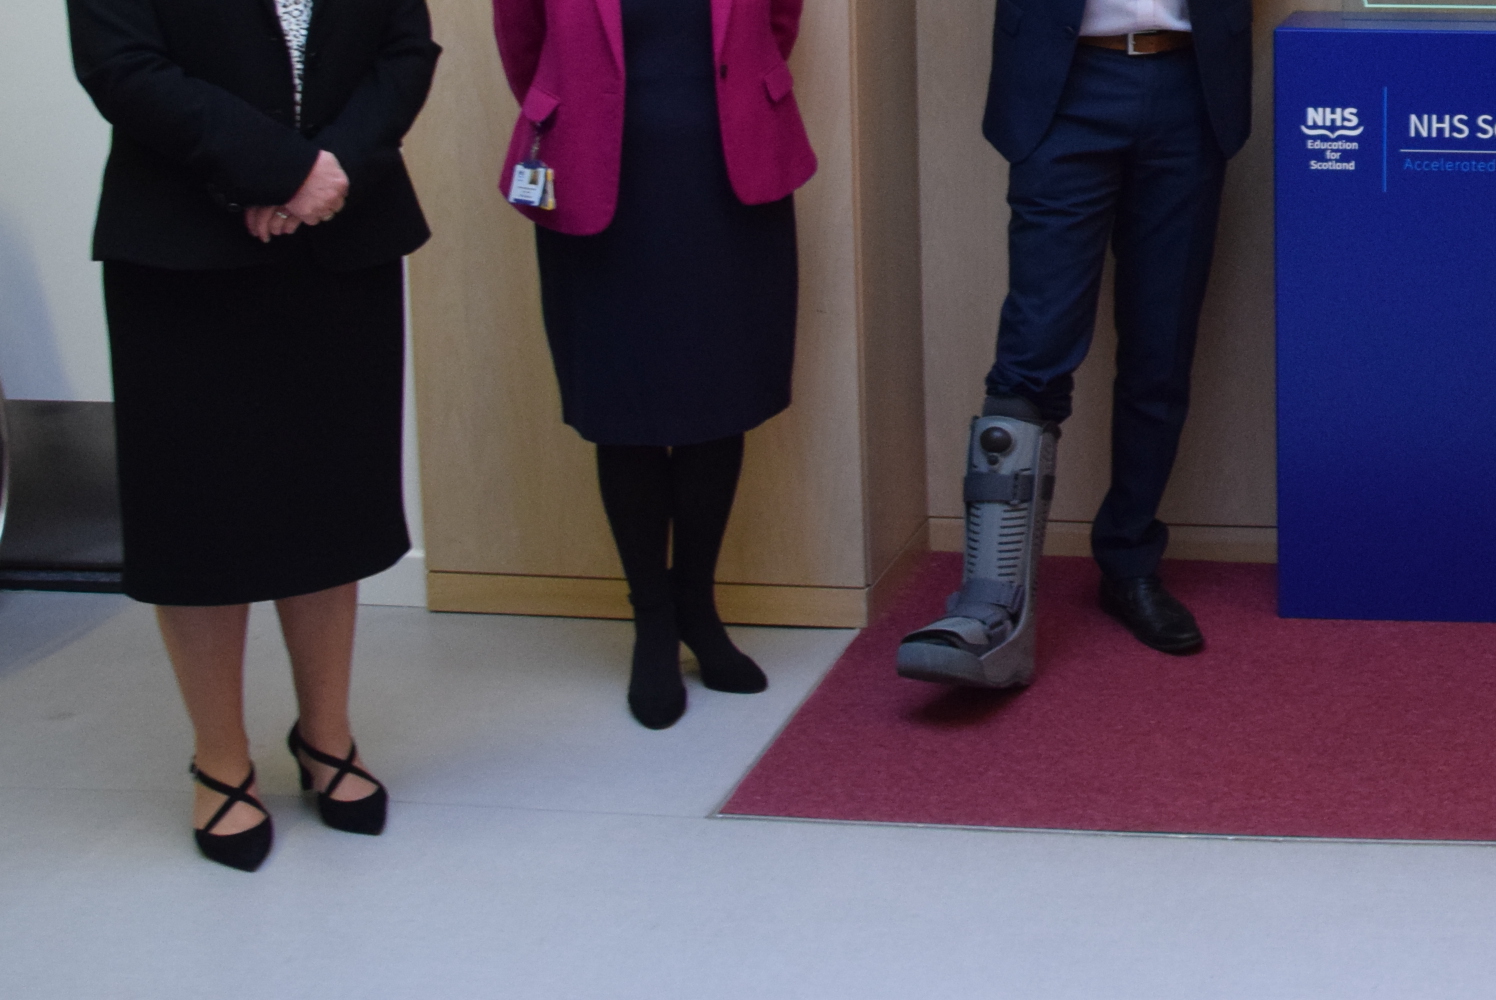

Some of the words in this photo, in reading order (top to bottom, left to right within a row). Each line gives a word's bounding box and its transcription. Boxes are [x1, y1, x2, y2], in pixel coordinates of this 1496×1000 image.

[1307, 107, 1359, 127] NHS
[1409, 114, 1469, 139] NHS
[1307, 139, 1359, 150] Education
[1325, 149, 1342, 160] for
[1309, 159, 1356, 170] Scotland
[1404, 158, 1496, 172] Accelerated
